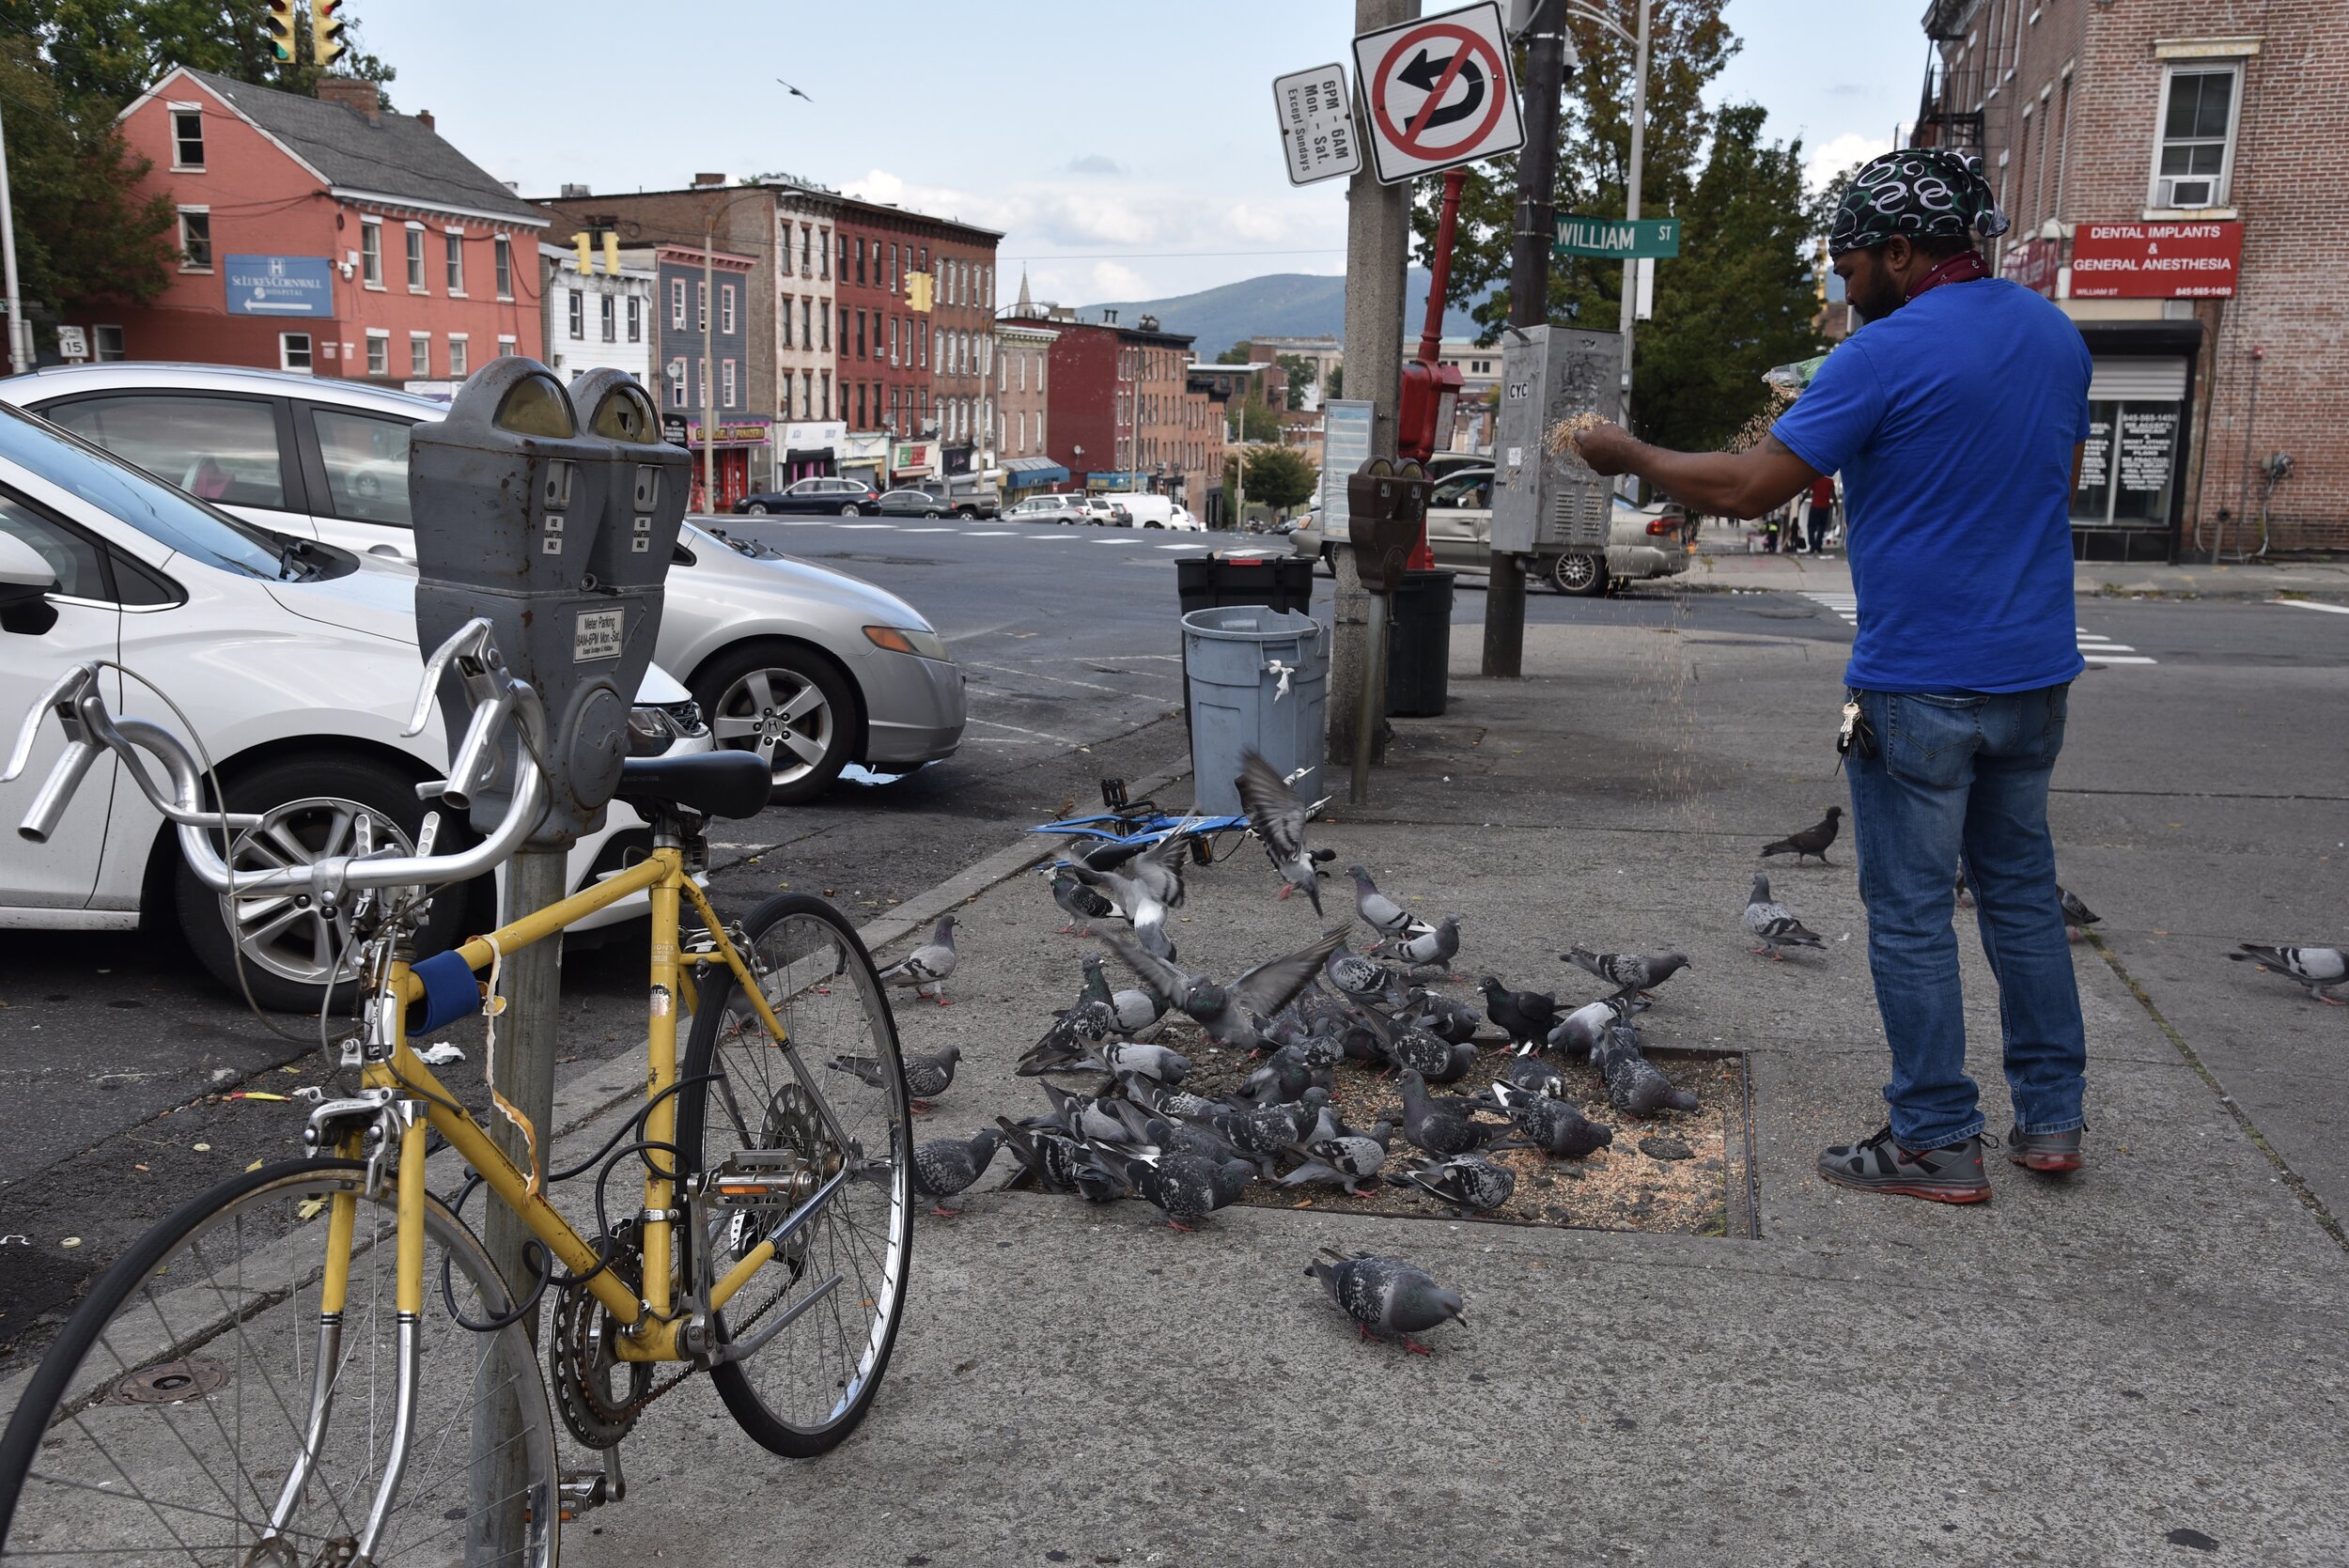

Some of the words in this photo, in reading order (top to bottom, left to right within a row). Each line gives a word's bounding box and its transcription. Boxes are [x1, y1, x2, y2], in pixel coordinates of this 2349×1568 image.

[1287, 88, 1304, 125] Except
[1304, 85, 1319, 117] Mon.
[1314, 136, 1330, 164] Sat.
[1322, 80, 1340, 110] 6PM
[1331, 129, 1349, 160] 6AM
[1295, 129, 1311, 172] Sundays
[1557, 222, 1635, 250] WILLIAM
[1658, 225, 1672, 241] ST
[2091, 226, 2144, 240] DENTAL
[2148, 225, 2220, 239] IMPLANTS
[2148, 242, 2157, 255] &
[271, 259, 283, 275] H
[2074, 258, 2139, 272] GENERAL
[2141, 257, 2232, 271] ANESTHESIA
[2076, 287, 2107, 296] WILLIAM
[66, 341, 84, 353] 15
[1510, 383, 1528, 398] CYC
[550, 518, 558, 528] USE
[545, 530, 563, 539] QUARTERS
[633, 530, 650, 538] QUARTERS
[548, 540, 557, 551] ONLY
[636, 540, 646, 549] ONLY
[584, 617, 599, 630] Meter
[599, 615, 615, 630] Parking
